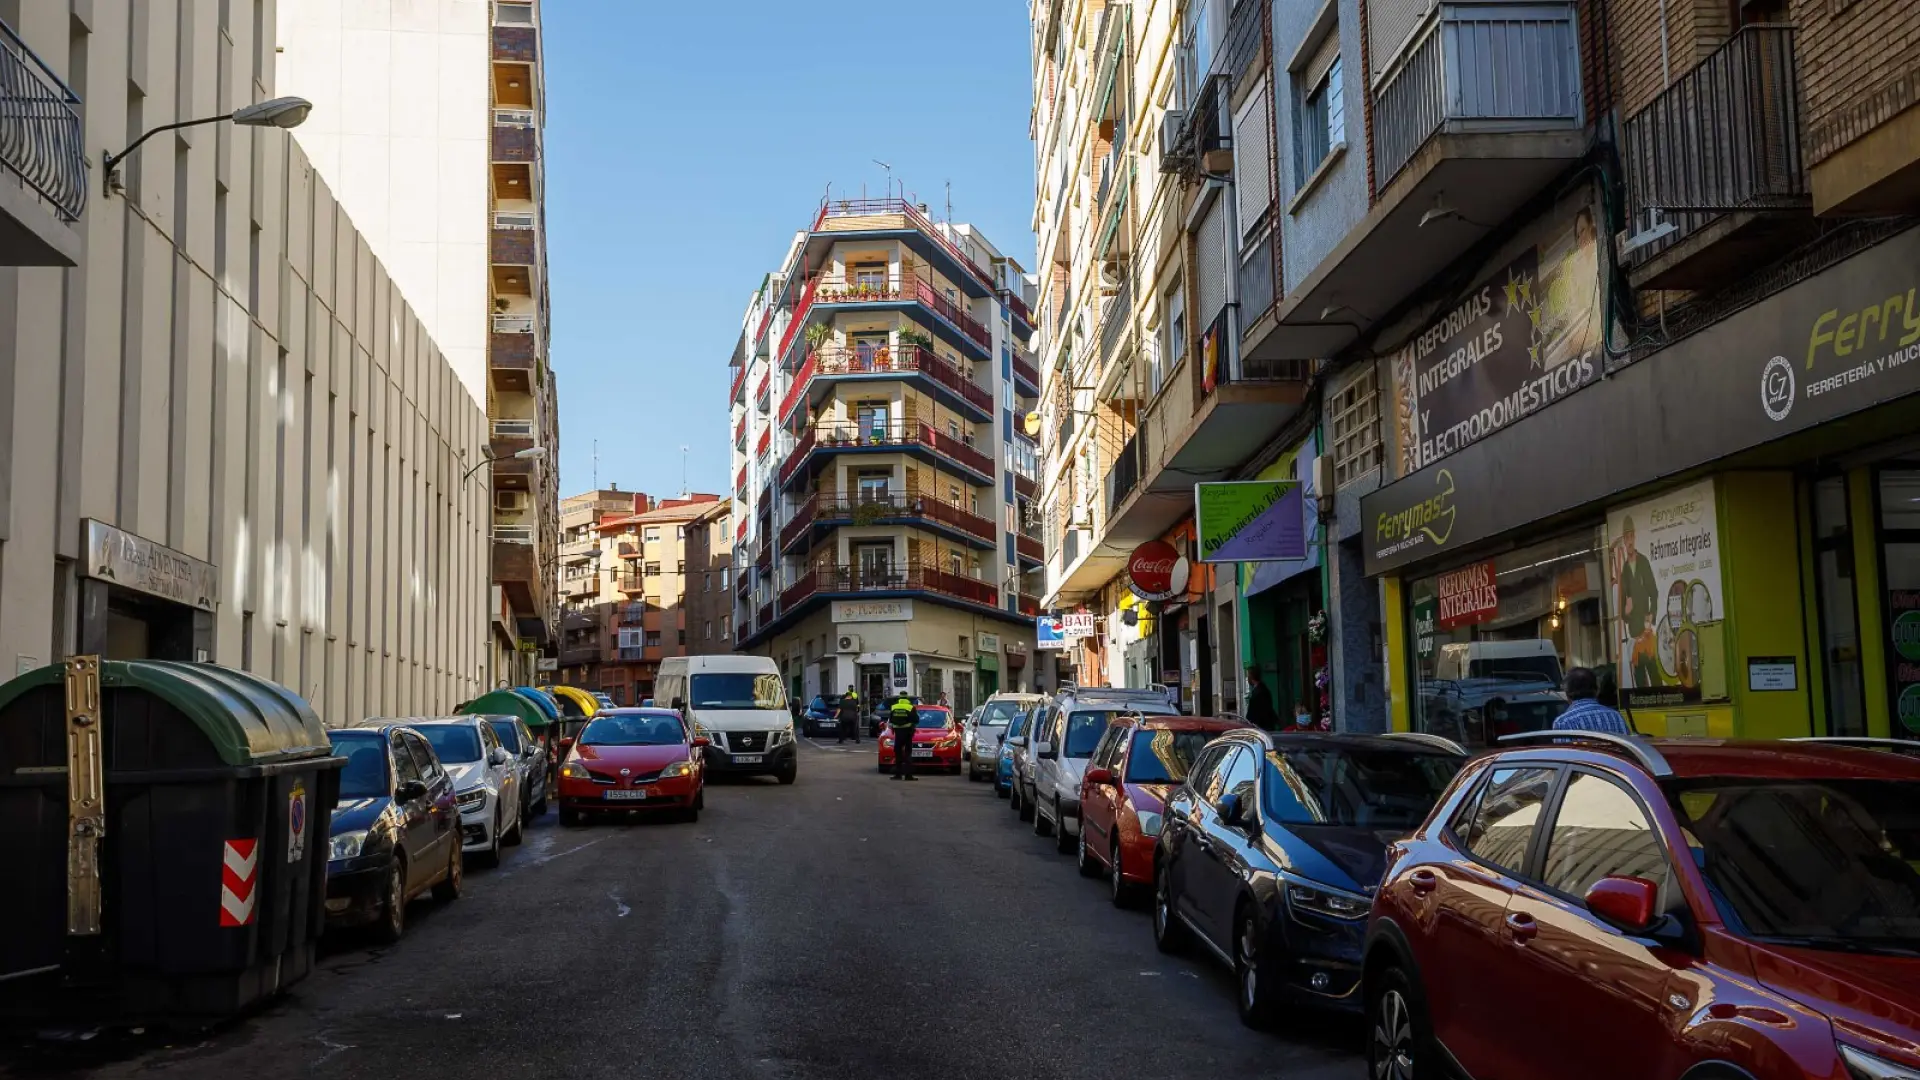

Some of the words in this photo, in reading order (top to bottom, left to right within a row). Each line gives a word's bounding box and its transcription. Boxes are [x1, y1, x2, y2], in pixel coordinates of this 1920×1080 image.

[1418, 286, 1491, 360] REFORMAS
[1420, 322, 1503, 398] INTEGRALES
[1806, 360, 1876, 398] FERRETERÍA
[1876, 357, 1886, 372] Y
[1888, 343, 1920, 369] MUC
[1421, 409, 1430, 434] Y
[1422, 351, 1594, 466] ELECTRODOMÉSTICOS
[1650, 538, 1678, 560] Reformas
[1680, 527, 1711, 557] Integrales
[1440, 563, 1489, 599] REFORMAS
[1440, 584, 1497, 620] INTEGRALES
[1065, 616, 1092, 626] BAR
